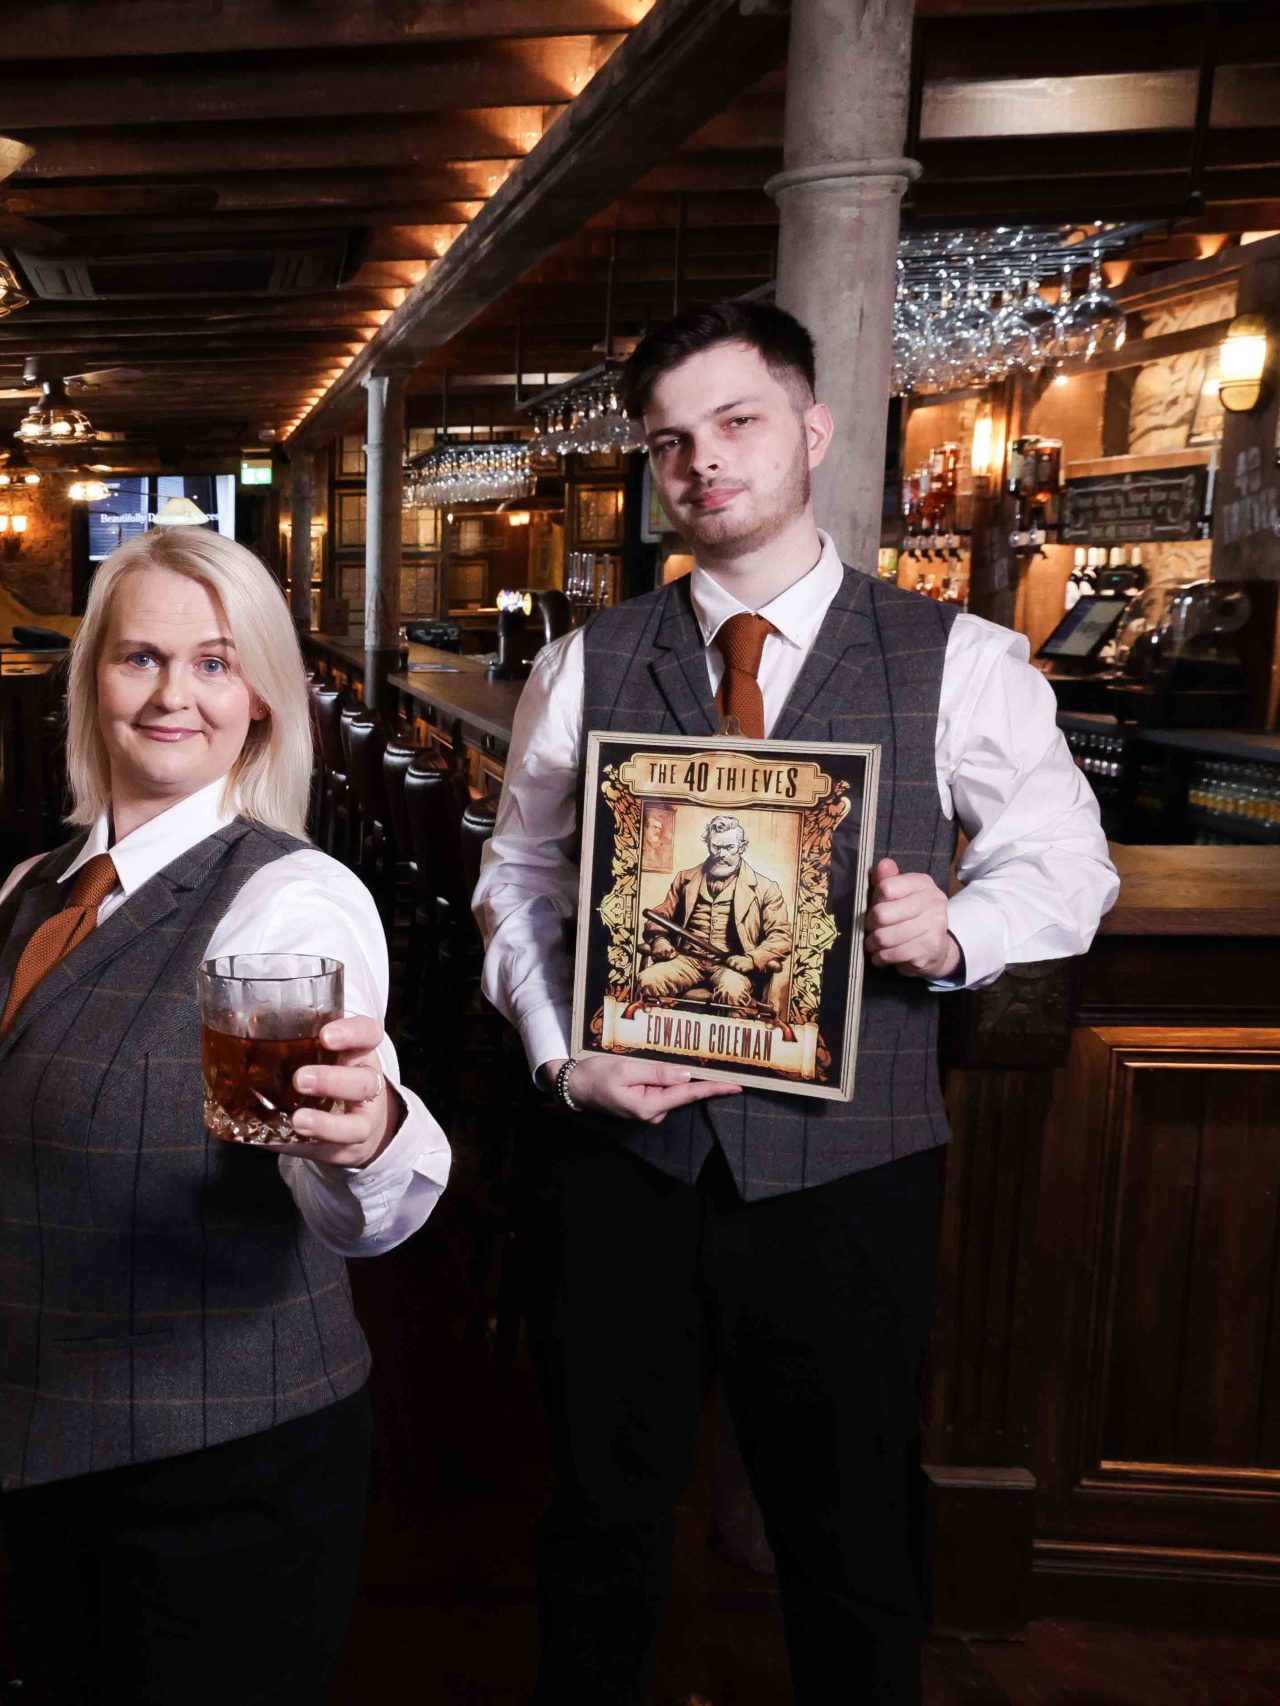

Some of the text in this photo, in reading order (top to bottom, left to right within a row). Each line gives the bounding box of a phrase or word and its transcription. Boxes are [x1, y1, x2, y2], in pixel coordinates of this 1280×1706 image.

[100, 513, 147, 524] Beautifully
[649, 761, 799, 798] THE 40 THIEVES
[646, 1014, 773, 1062] EDWARD COLEMAN
